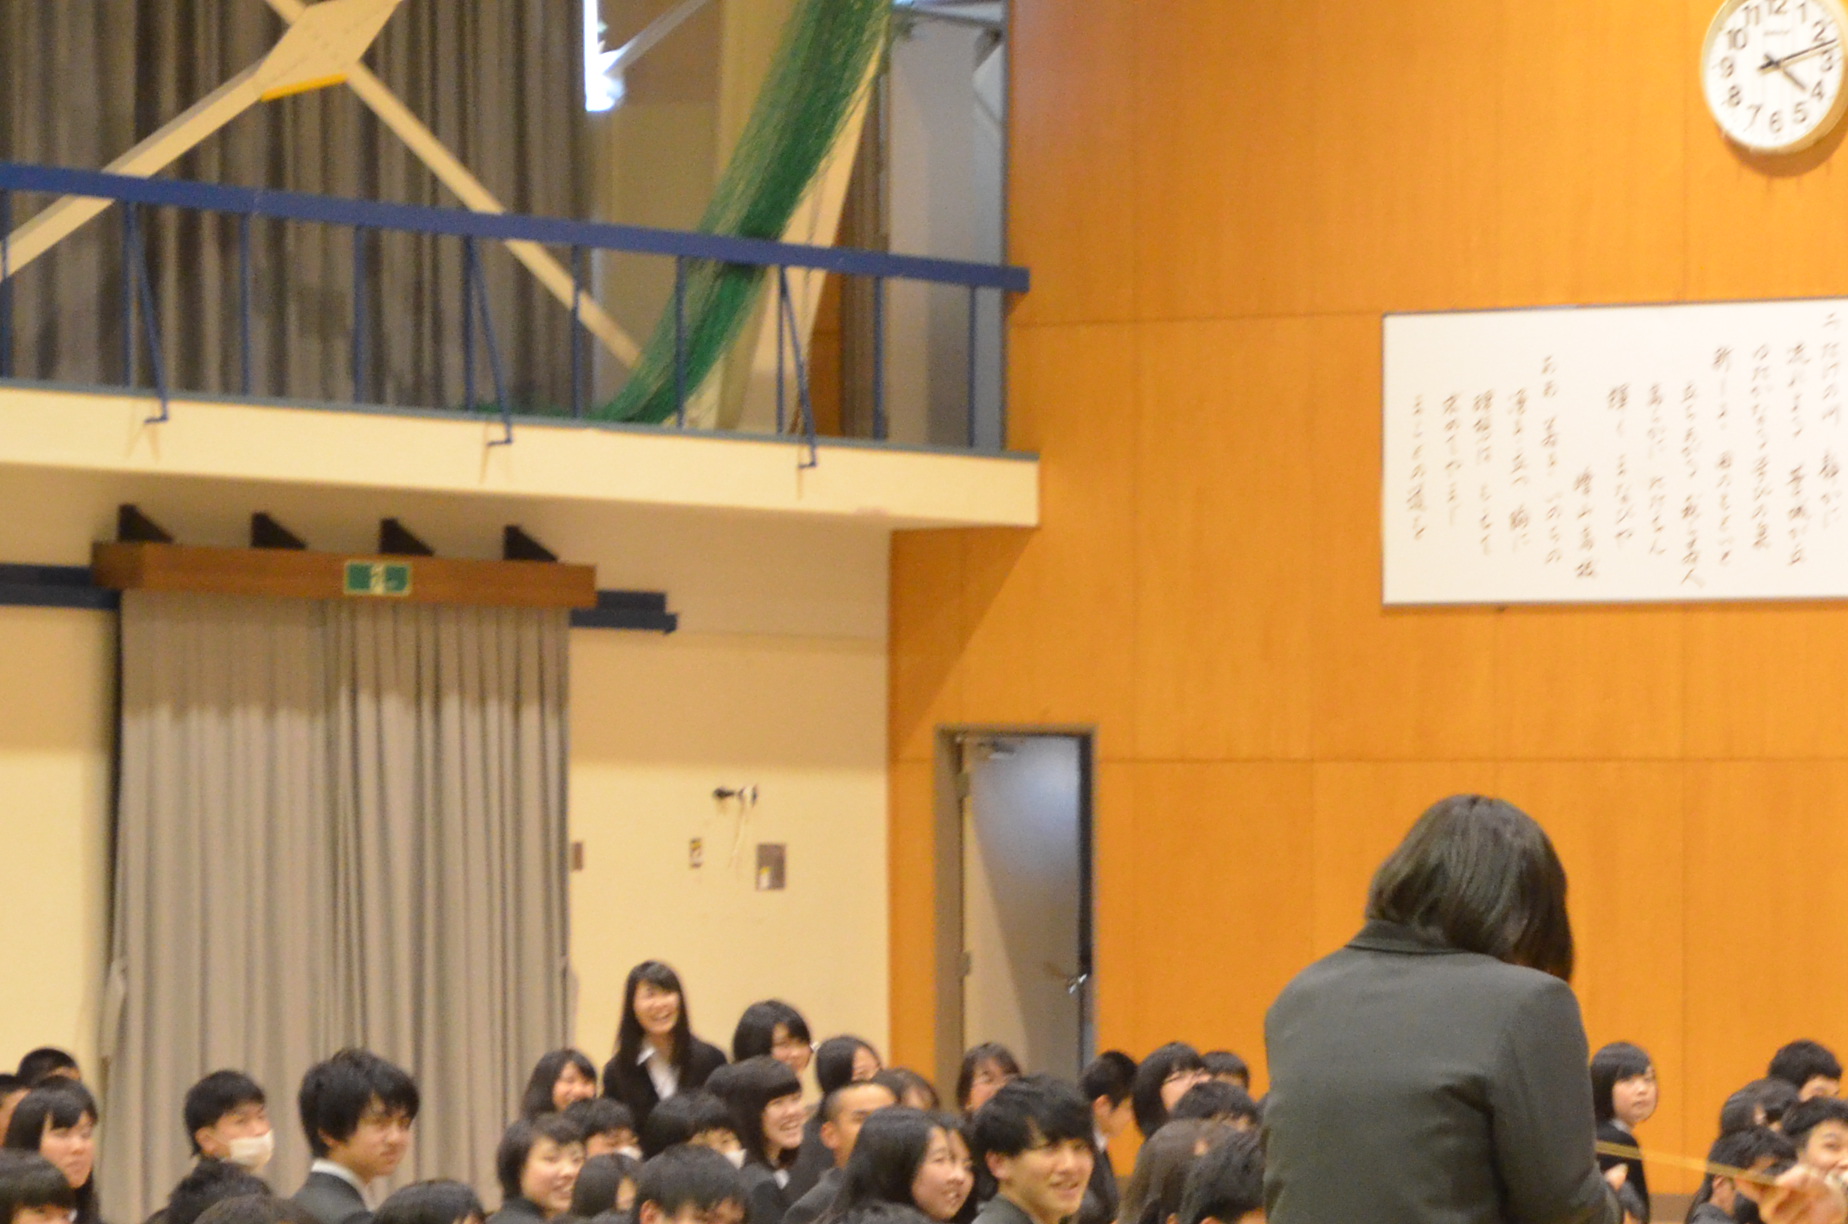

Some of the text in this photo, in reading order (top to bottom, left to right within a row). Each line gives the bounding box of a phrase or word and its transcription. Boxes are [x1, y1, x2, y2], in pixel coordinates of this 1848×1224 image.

[1743, 5, 1760, 25] 11
[1798, 2, 1807, 22] 1
[1727, 28, 1748, 50] 10
[1812, 19, 1826, 42] 2
[1720, 57, 1734, 78] 9
[1821, 49, 1833, 72] 3
[1729, 85, 1741, 107] 8
[1812, 80, 1824, 101] 4
[1747, 103, 1762, 132] 7
[1769, 111, 1783, 133] 6
[1794, 102, 1808, 123] 5
